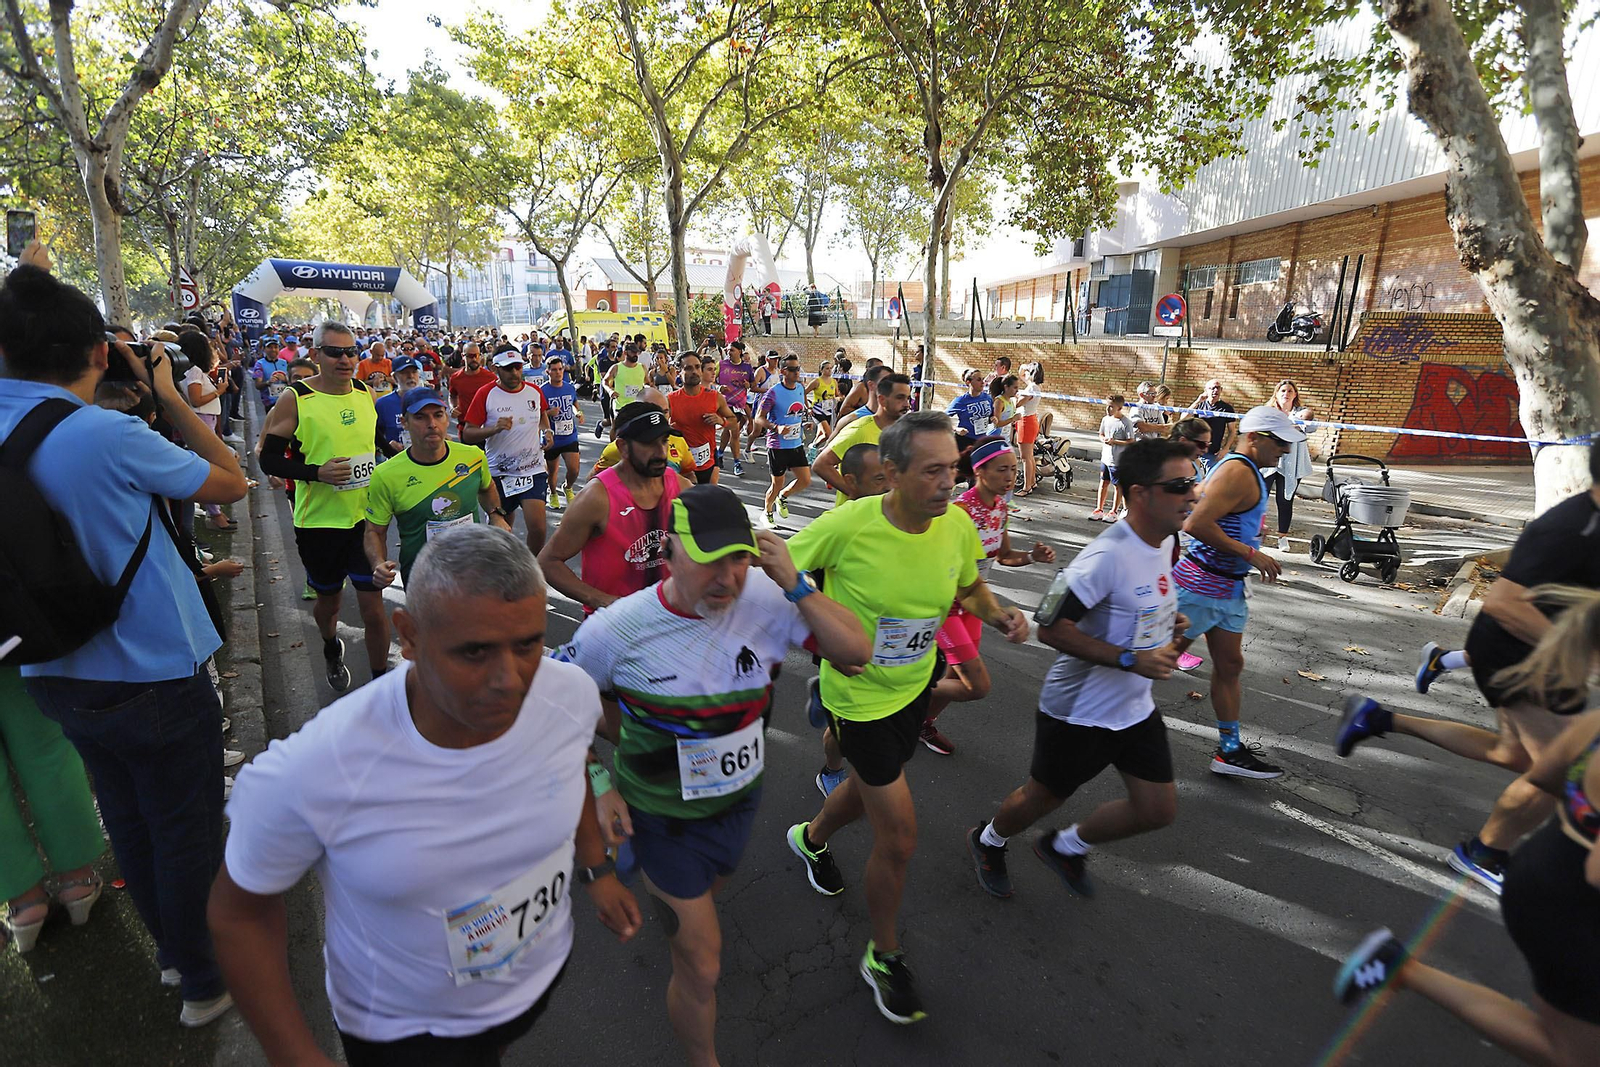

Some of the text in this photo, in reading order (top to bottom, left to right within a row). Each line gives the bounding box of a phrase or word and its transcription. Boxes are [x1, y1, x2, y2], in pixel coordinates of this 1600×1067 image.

[322, 268, 385, 281] HYUNDAI
[352, 282, 385, 290] SYRLUZ
[698, 449, 710, 460] 573
[353, 461, 375, 479] 656
[515, 475, 532, 487] 475
[721, 736, 758, 776] 661
[511, 870, 565, 939] 730
